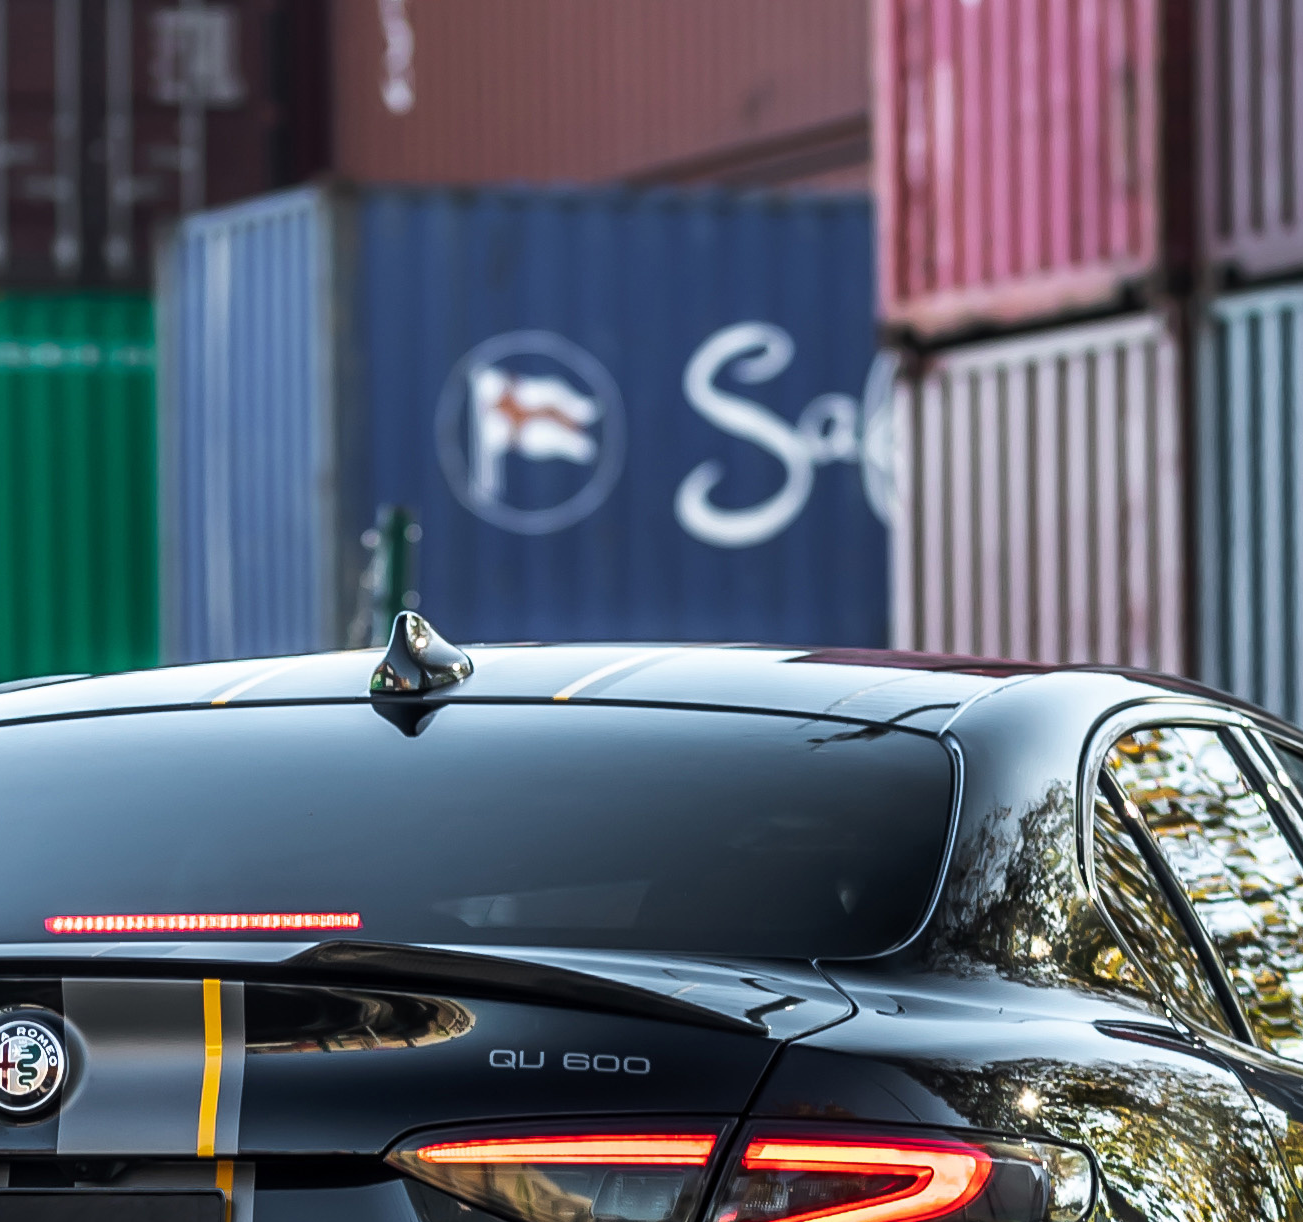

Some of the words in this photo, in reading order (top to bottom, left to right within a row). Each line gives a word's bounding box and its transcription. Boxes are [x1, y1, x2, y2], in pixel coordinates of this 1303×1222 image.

[16, 1026, 58, 1067] ROMEO
[489, 1049, 545, 1069] QU
[563, 1052, 651, 1074] 600
